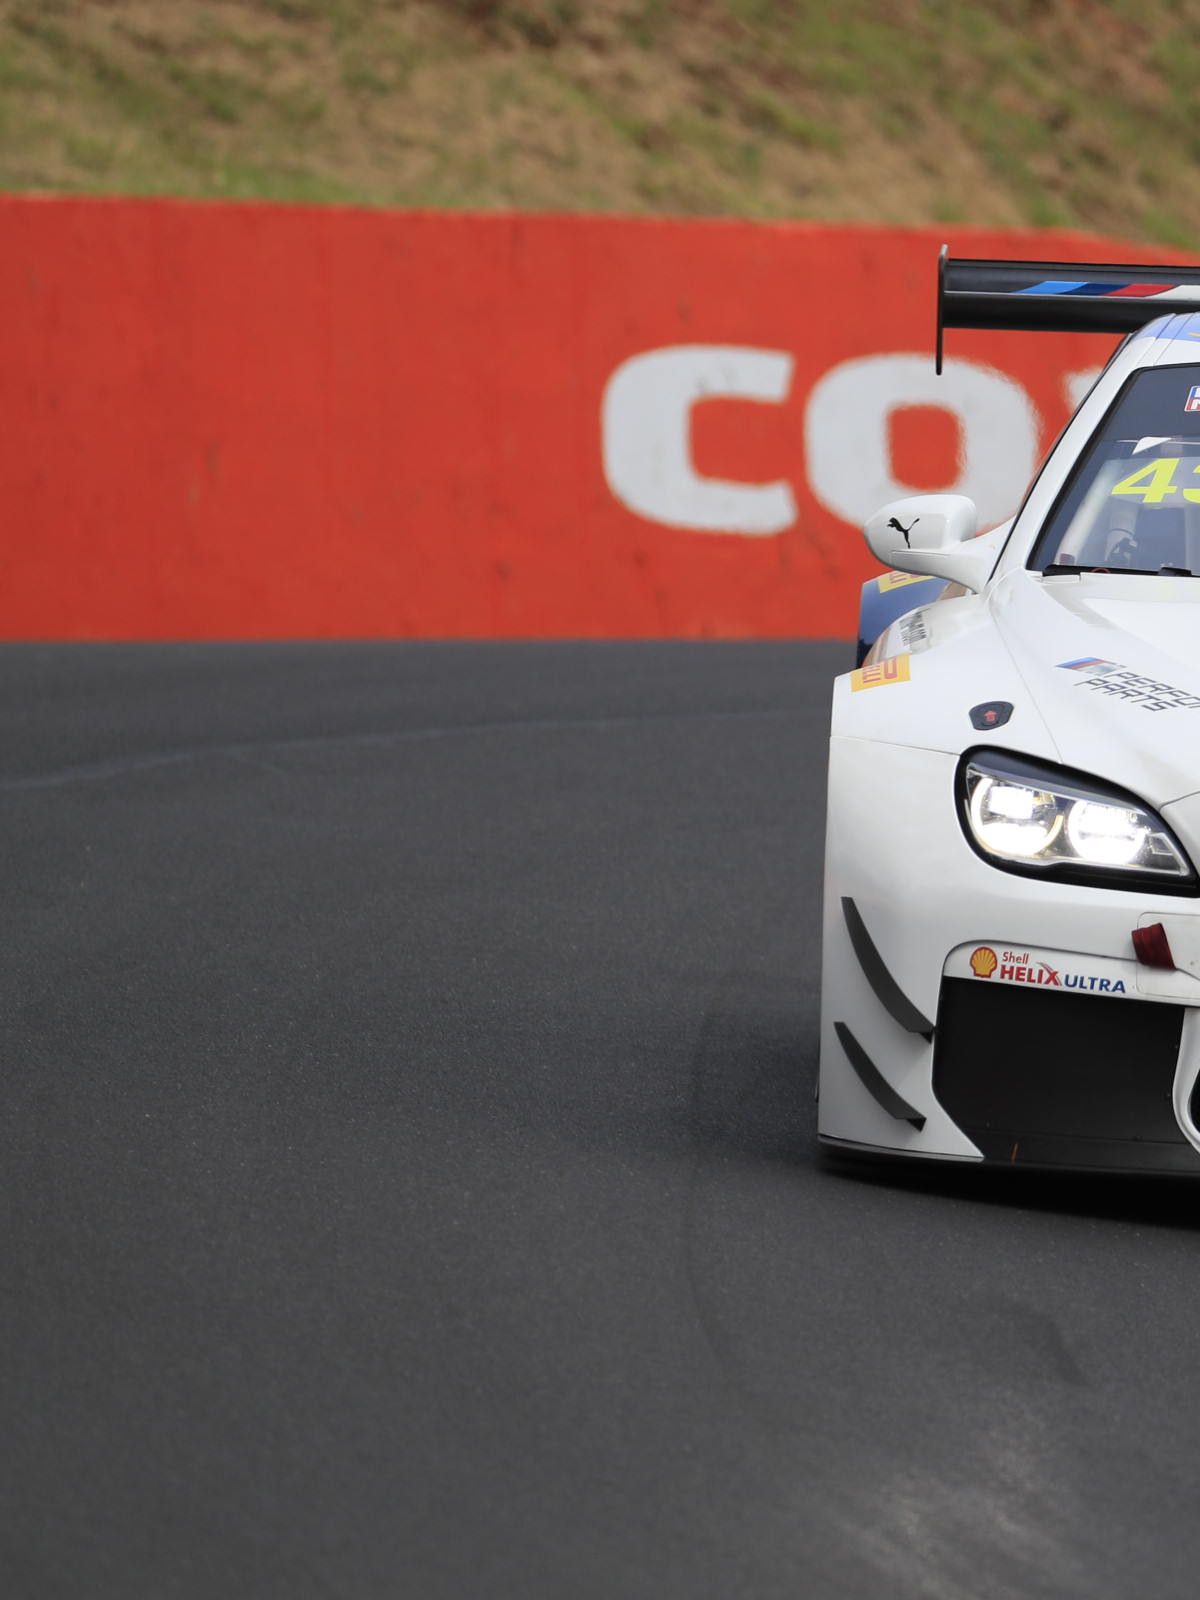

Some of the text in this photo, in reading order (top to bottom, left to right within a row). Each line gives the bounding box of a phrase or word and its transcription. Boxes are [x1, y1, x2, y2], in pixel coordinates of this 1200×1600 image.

[1074, 678, 1178, 712] PARTS
[1002, 951, 1029, 965] Shell
[1000, 965, 1126, 994] HELIX ULTRA
